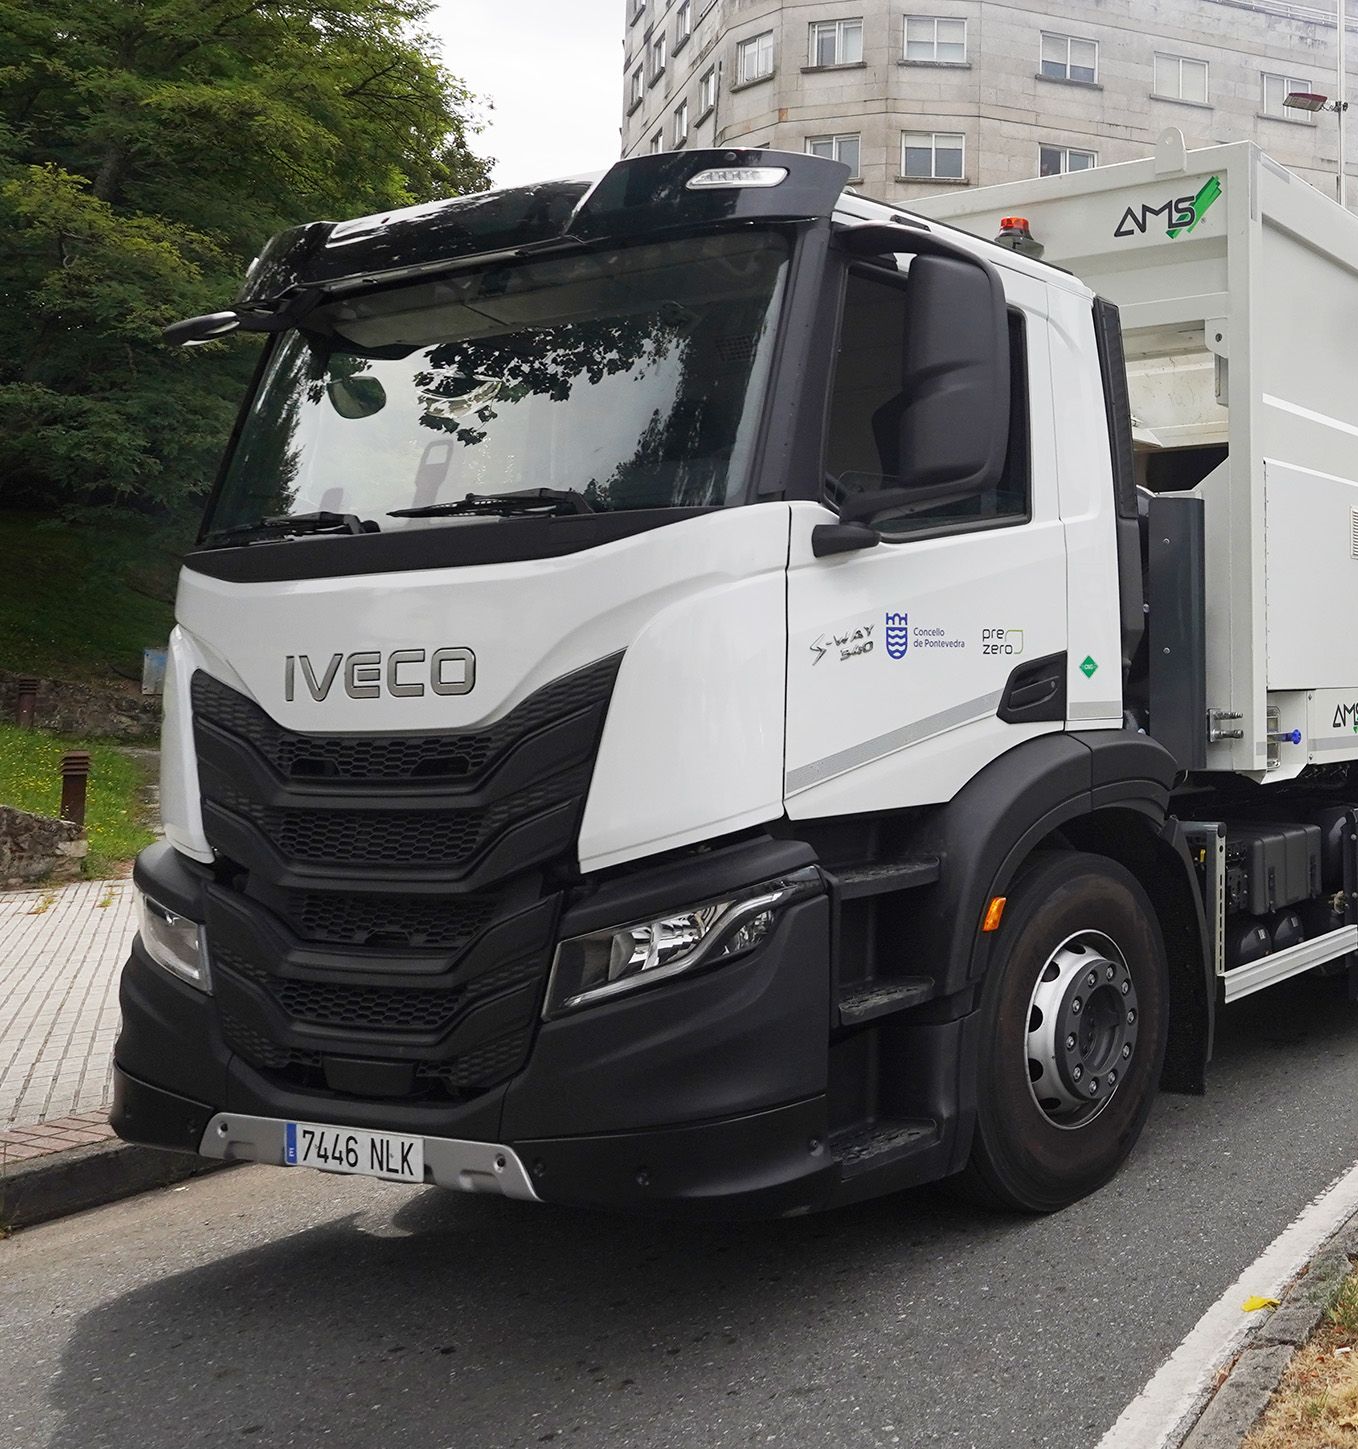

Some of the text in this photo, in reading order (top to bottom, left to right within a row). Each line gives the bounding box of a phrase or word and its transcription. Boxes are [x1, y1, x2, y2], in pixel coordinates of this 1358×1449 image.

[1114, 195, 1196, 238] AMS
[913, 627, 945, 637] Concello
[982, 628, 1005, 642] pre
[913, 638, 966, 648] de Pontevedra
[982, 643, 1013, 655] zero
[285, 646, 477, 702] IVECO
[302, 1130, 415, 1177] 7446 NLK
